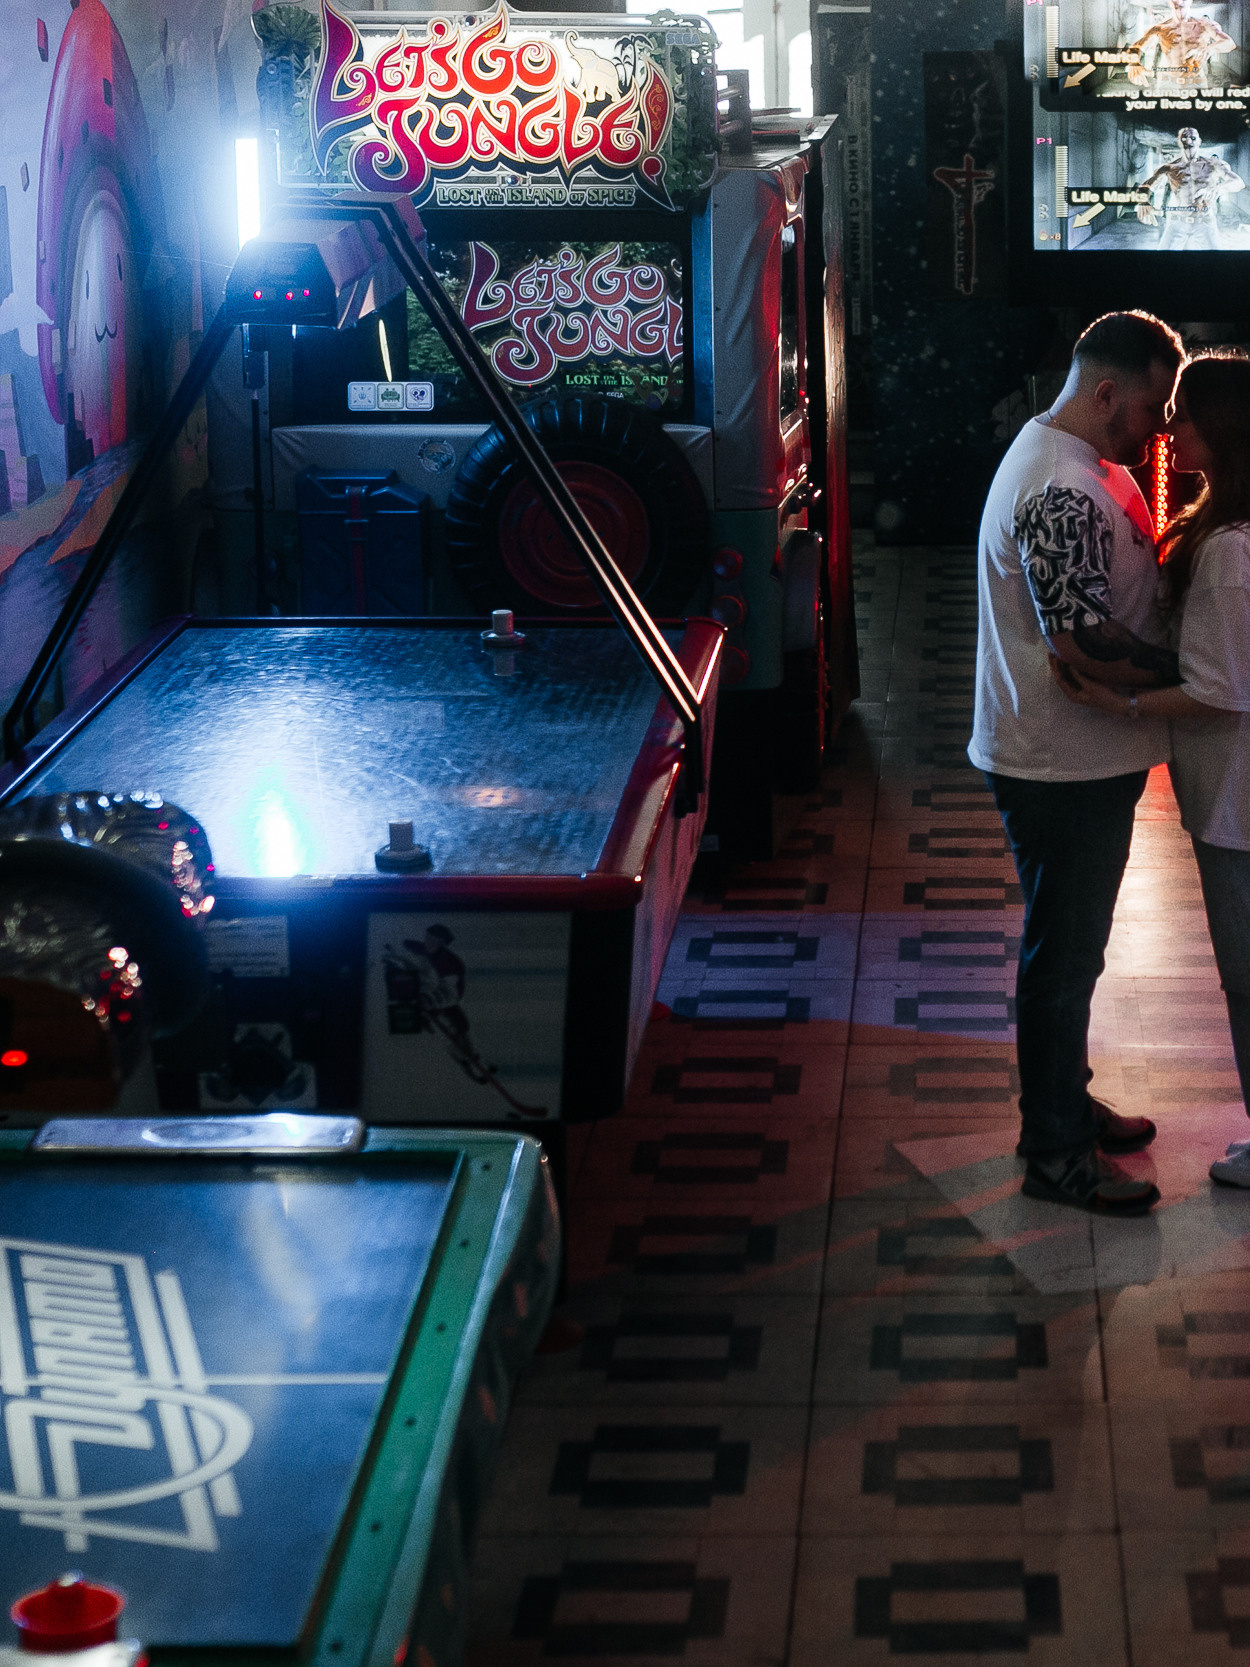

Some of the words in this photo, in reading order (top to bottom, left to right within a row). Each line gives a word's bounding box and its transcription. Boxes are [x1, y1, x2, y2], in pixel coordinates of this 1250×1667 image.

[460, 0, 559, 97] GO
[1062, 51, 1091, 64] Life
[1094, 51, 1140, 64] Marks
[1142, 87, 1198, 99] damage
[1200, 87, 1225, 98] will
[1126, 100, 1157, 111] your
[1160, 99, 1192, 109] lives
[1195, 99, 1213, 111] by
[1215, 100, 1247, 110] one.
[347, 58, 677, 197] JUNGLE!
[437, 187, 482, 203] LOST
[506, 187, 568, 203] ISLAND
[570, 191, 586, 203] OF
[587, 187, 635, 203] SPICE
[1071, 190, 1100, 203] Life
[1103, 190, 1149, 203] Marks
[582, 242, 666, 309] GO
[565, 374, 600, 386] LOST
[620, 375, 669, 386] ISAND
